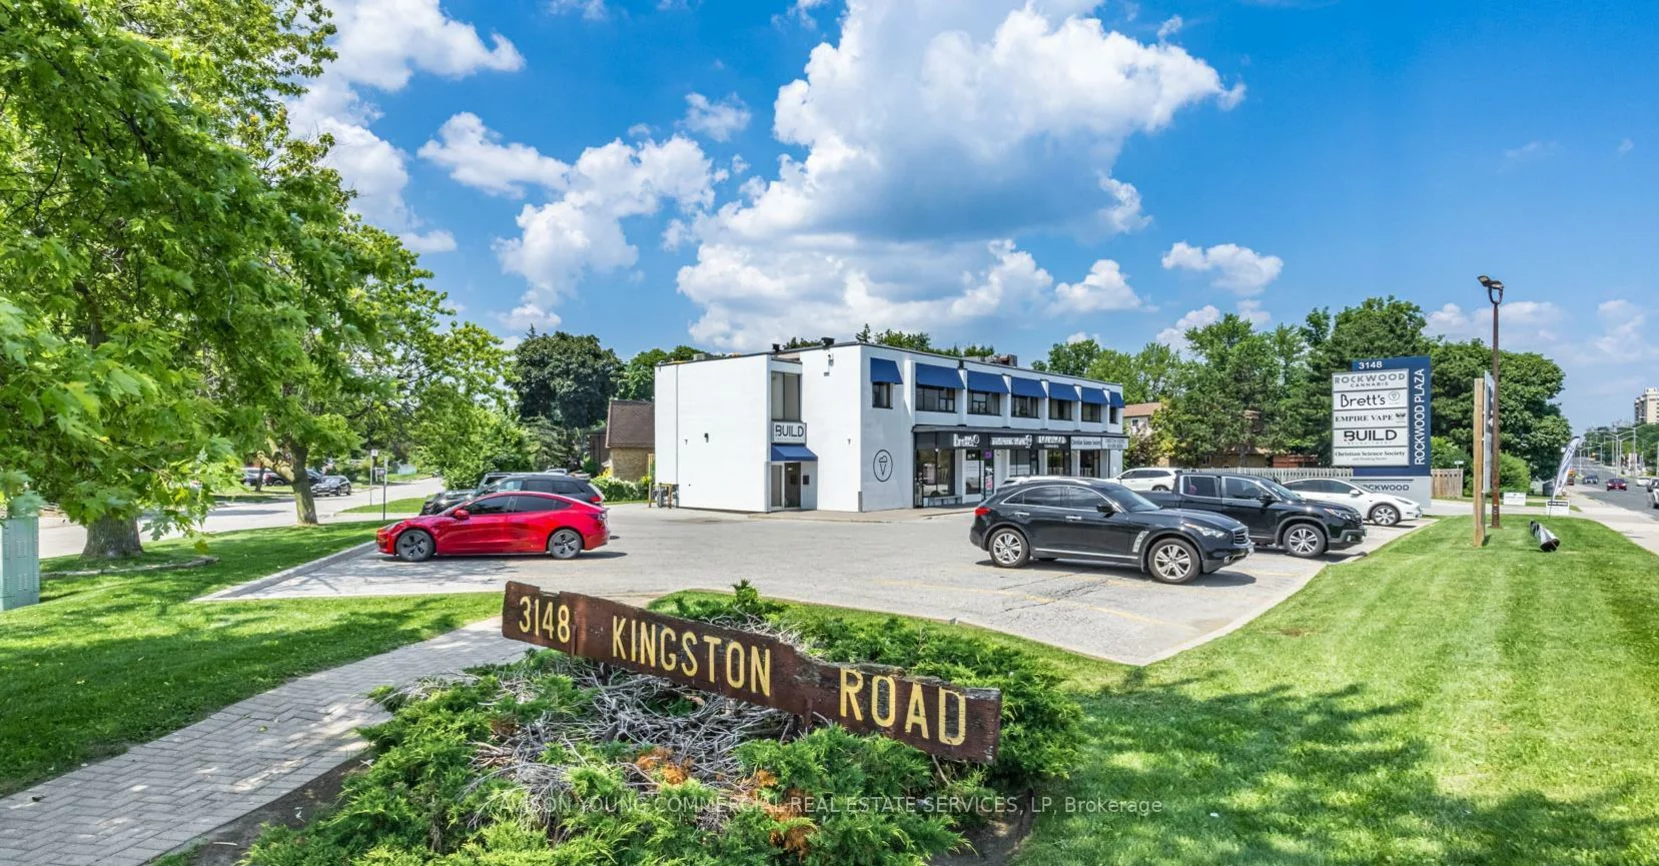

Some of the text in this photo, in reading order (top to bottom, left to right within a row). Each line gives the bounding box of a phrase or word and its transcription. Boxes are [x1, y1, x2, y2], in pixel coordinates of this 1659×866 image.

[1358, 361, 1383, 370] 3148
[1334, 373, 1405, 384] ROCKWOOD
[1340, 393, 1386, 408] Brett's
[1414, 368, 1425, 465] ROCKWOOD PLAZA
[775, 424, 805, 438] BUILD
[1343, 429, 1398, 442] BUILD
[518, 596, 966, 746] 3148 KINGSTON ROAD
